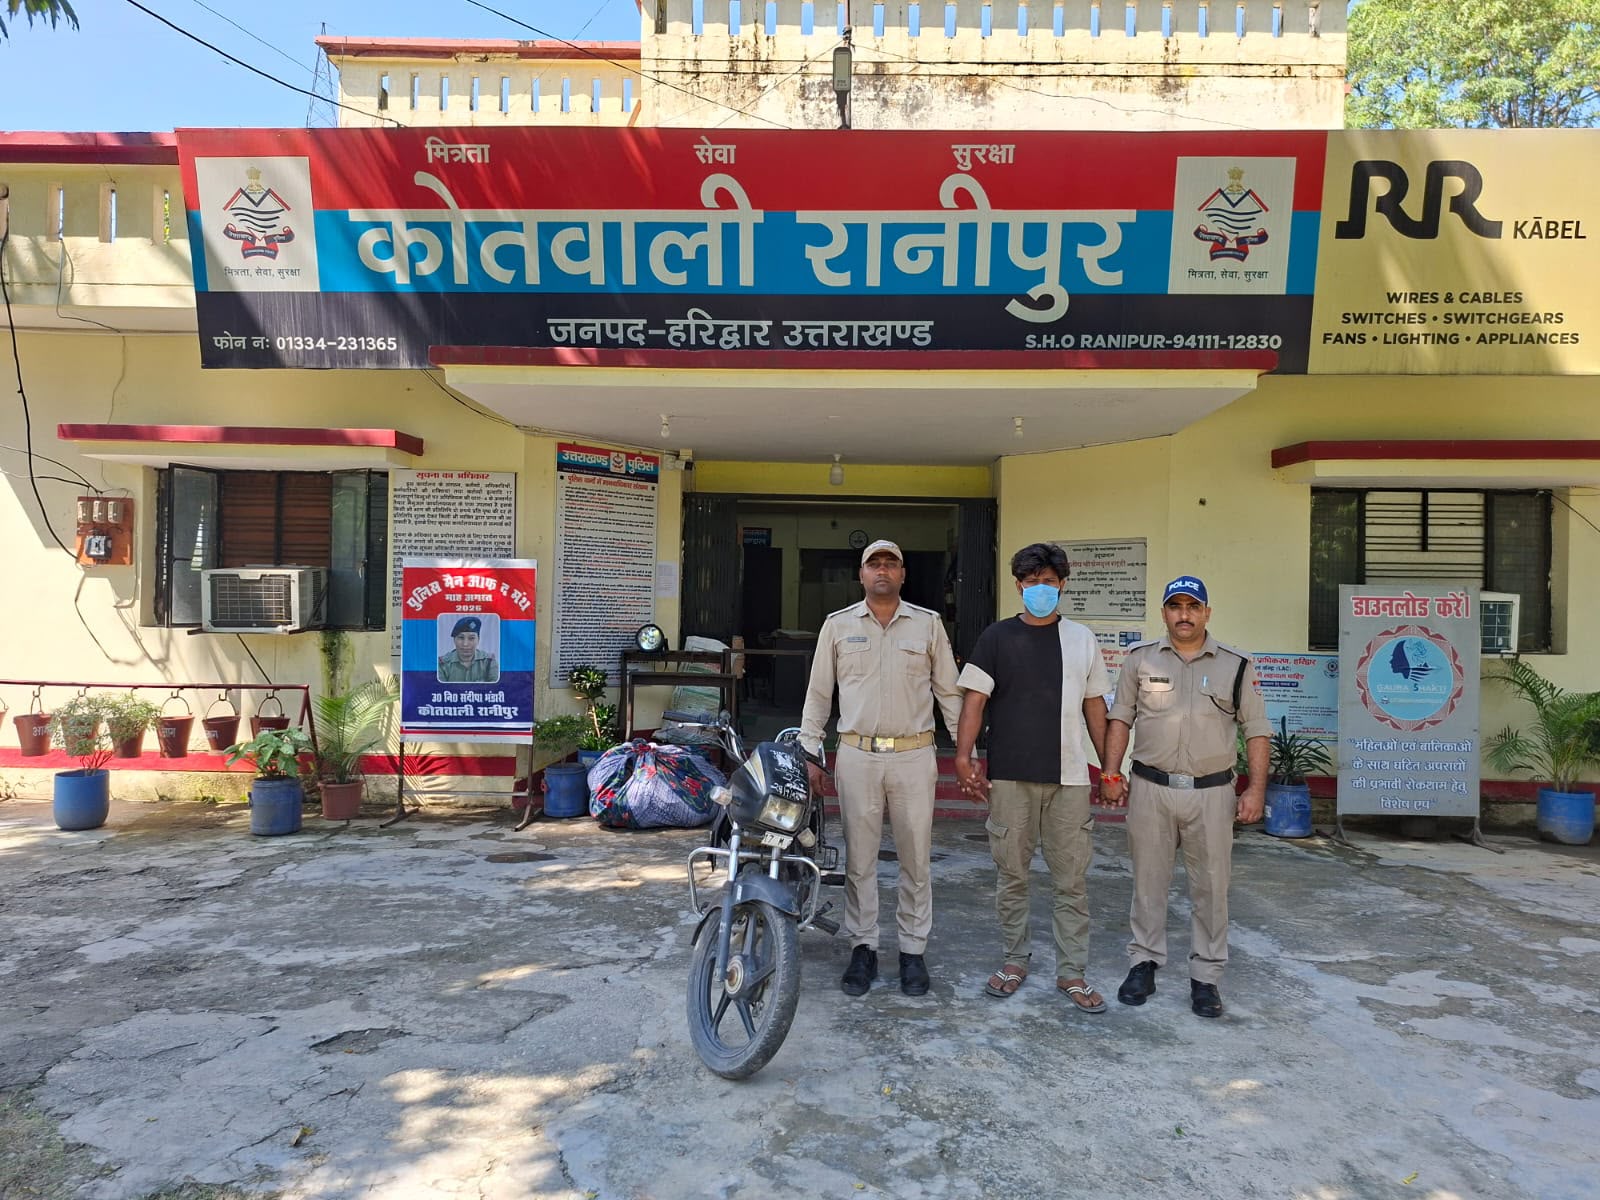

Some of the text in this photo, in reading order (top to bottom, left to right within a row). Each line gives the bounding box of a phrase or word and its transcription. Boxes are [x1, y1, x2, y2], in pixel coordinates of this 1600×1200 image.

[425, 136, 490, 164] मित्रता
[694, 136, 736, 164] सेवा
[952, 142, 1015, 171] सुरक्षा
[1334, 160, 1503, 239] RR
[348, 171, 1136, 323] कोतवाली रानीपुर
[224, 266, 300, 279] मित्रता, सेवा, सुरक्षा
[1188, 268, 1269, 282] मित्रता, सेवा, सुरक्षा
[1387, 291, 1523, 304] WIRES & CABLES
[1341, 312, 1564, 325] SWITCHES SWITCHGEARS
[547, 307, 934, 349] जनपद-हरिद्वार उत्तराखण्ड
[213, 331, 247, 350] फोन
[276, 336, 397, 350] 01334-231365
[1024, 334, 1282, 349] S.H.O RANIPUR-94111-12830
[1322, 332, 1580, 345] FANS LIGHTING APPLIANCES
[562, 450, 609, 466] उत्तराखण्ड
[628, 457, 654, 474] पुलिस
[406, 581, 442, 611] पुलिस
[442, 574, 464, 588] मैन
[500, 582, 510, 596] द
[1169, 581, 1199, 592] POLICE
[1351, 591, 1431, 617] डाउनलोड
[417, 704, 519, 720] कोतवाली रानीपुर
[1352, 756, 1363, 769] के
[1367, 760, 1390, 770] साथ
[1394, 759, 1420, 770] घटित
[1352, 777, 1467, 794] की प्रभावी रोकथाम हेतु
[1381, 796, 1410, 809] विशेष
